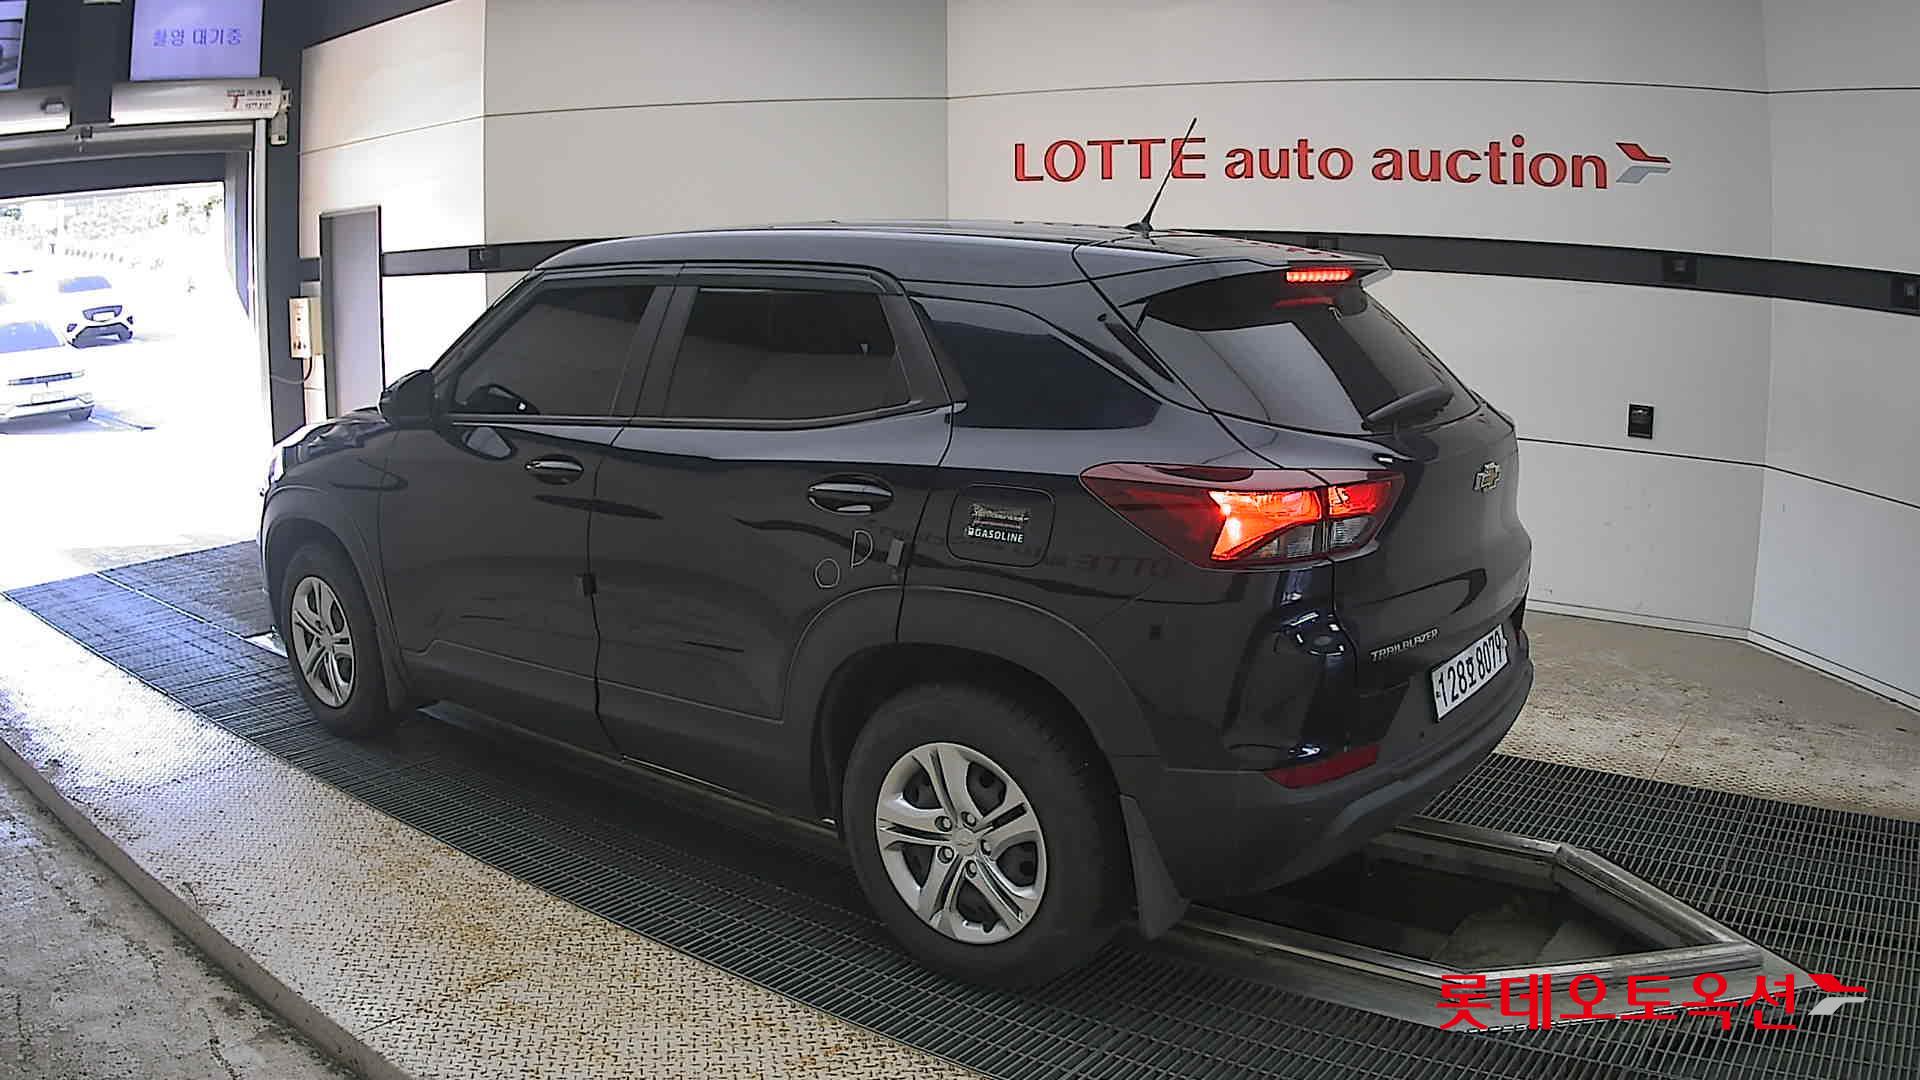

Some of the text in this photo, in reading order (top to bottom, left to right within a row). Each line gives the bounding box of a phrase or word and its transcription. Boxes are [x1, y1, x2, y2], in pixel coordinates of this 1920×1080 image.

[192, 27, 242, 46] 대기중
[1014, 135, 1608, 189] LOTTE auto auction
[975, 528, 1024, 543] GASOLINE
[1370, 628, 1440, 662] TRAILBLAZER
[1476, 630, 1503, 680] 8079
